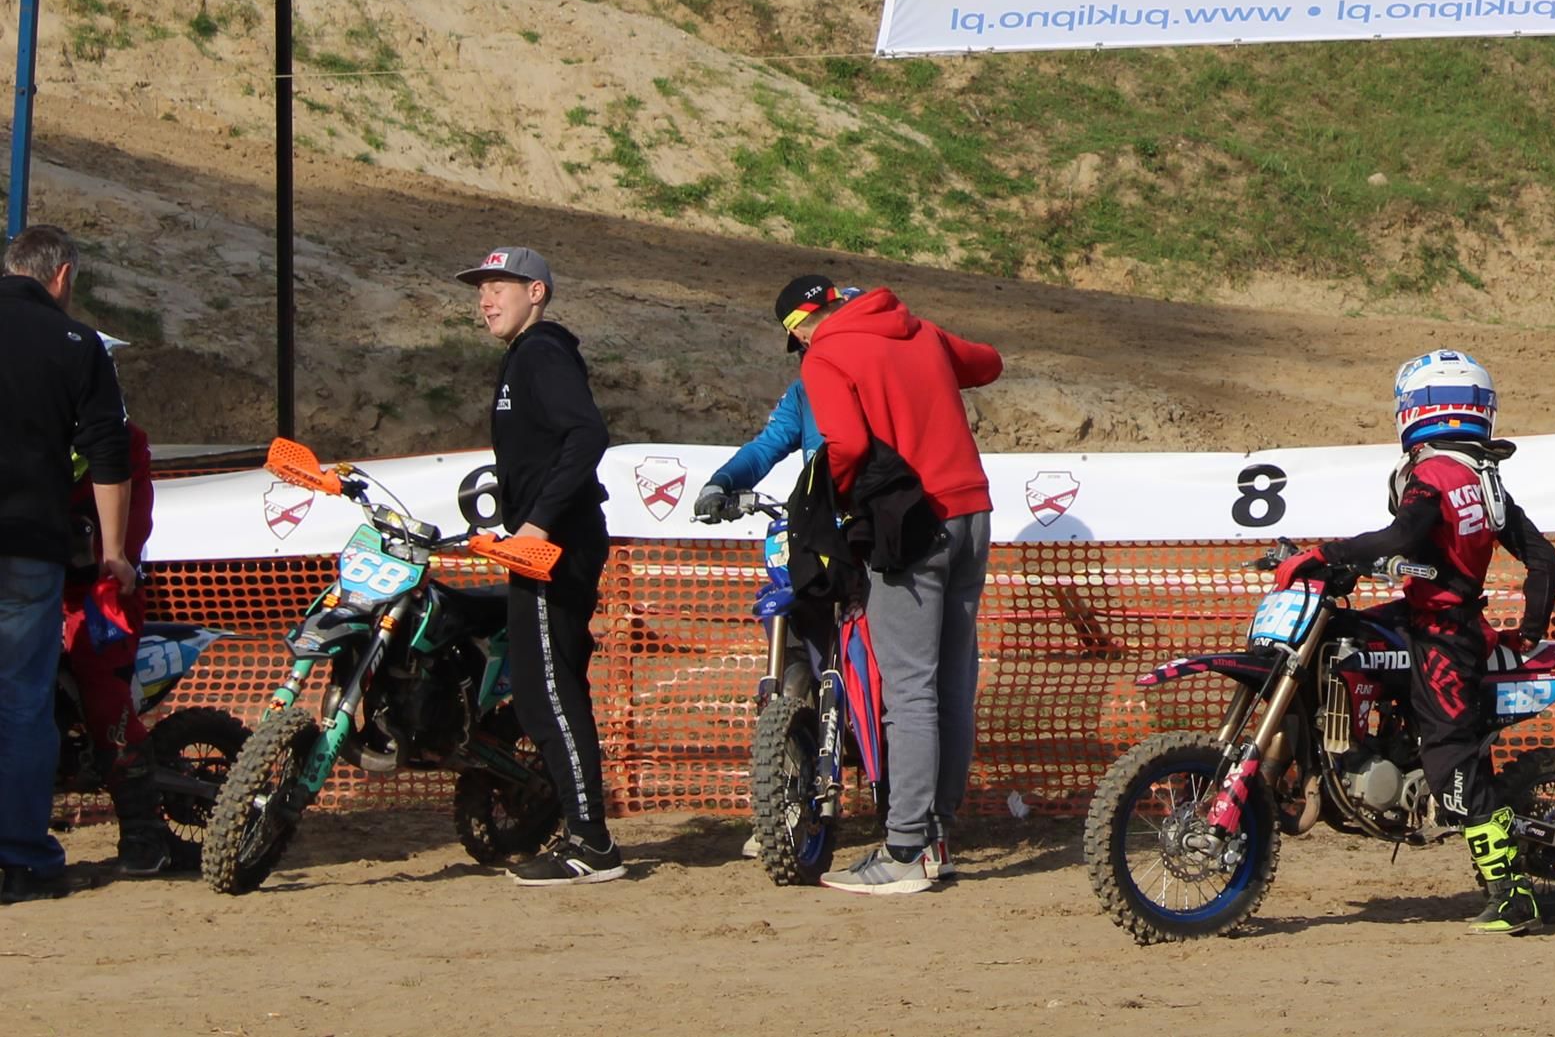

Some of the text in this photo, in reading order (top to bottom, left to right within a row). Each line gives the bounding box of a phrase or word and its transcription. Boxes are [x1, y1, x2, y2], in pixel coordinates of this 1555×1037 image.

[458, 464, 502, 528] 6
[1231, 464, 1287, 527] 8
[341, 552, 411, 596] 68
[1251, 591, 1316, 641] 282
[1358, 650, 1412, 670] LIPNO
[1355, 683, 1375, 695] FUNT
[1496, 681, 1551, 715] 282
[1454, 768, 1464, 802] FUNT
